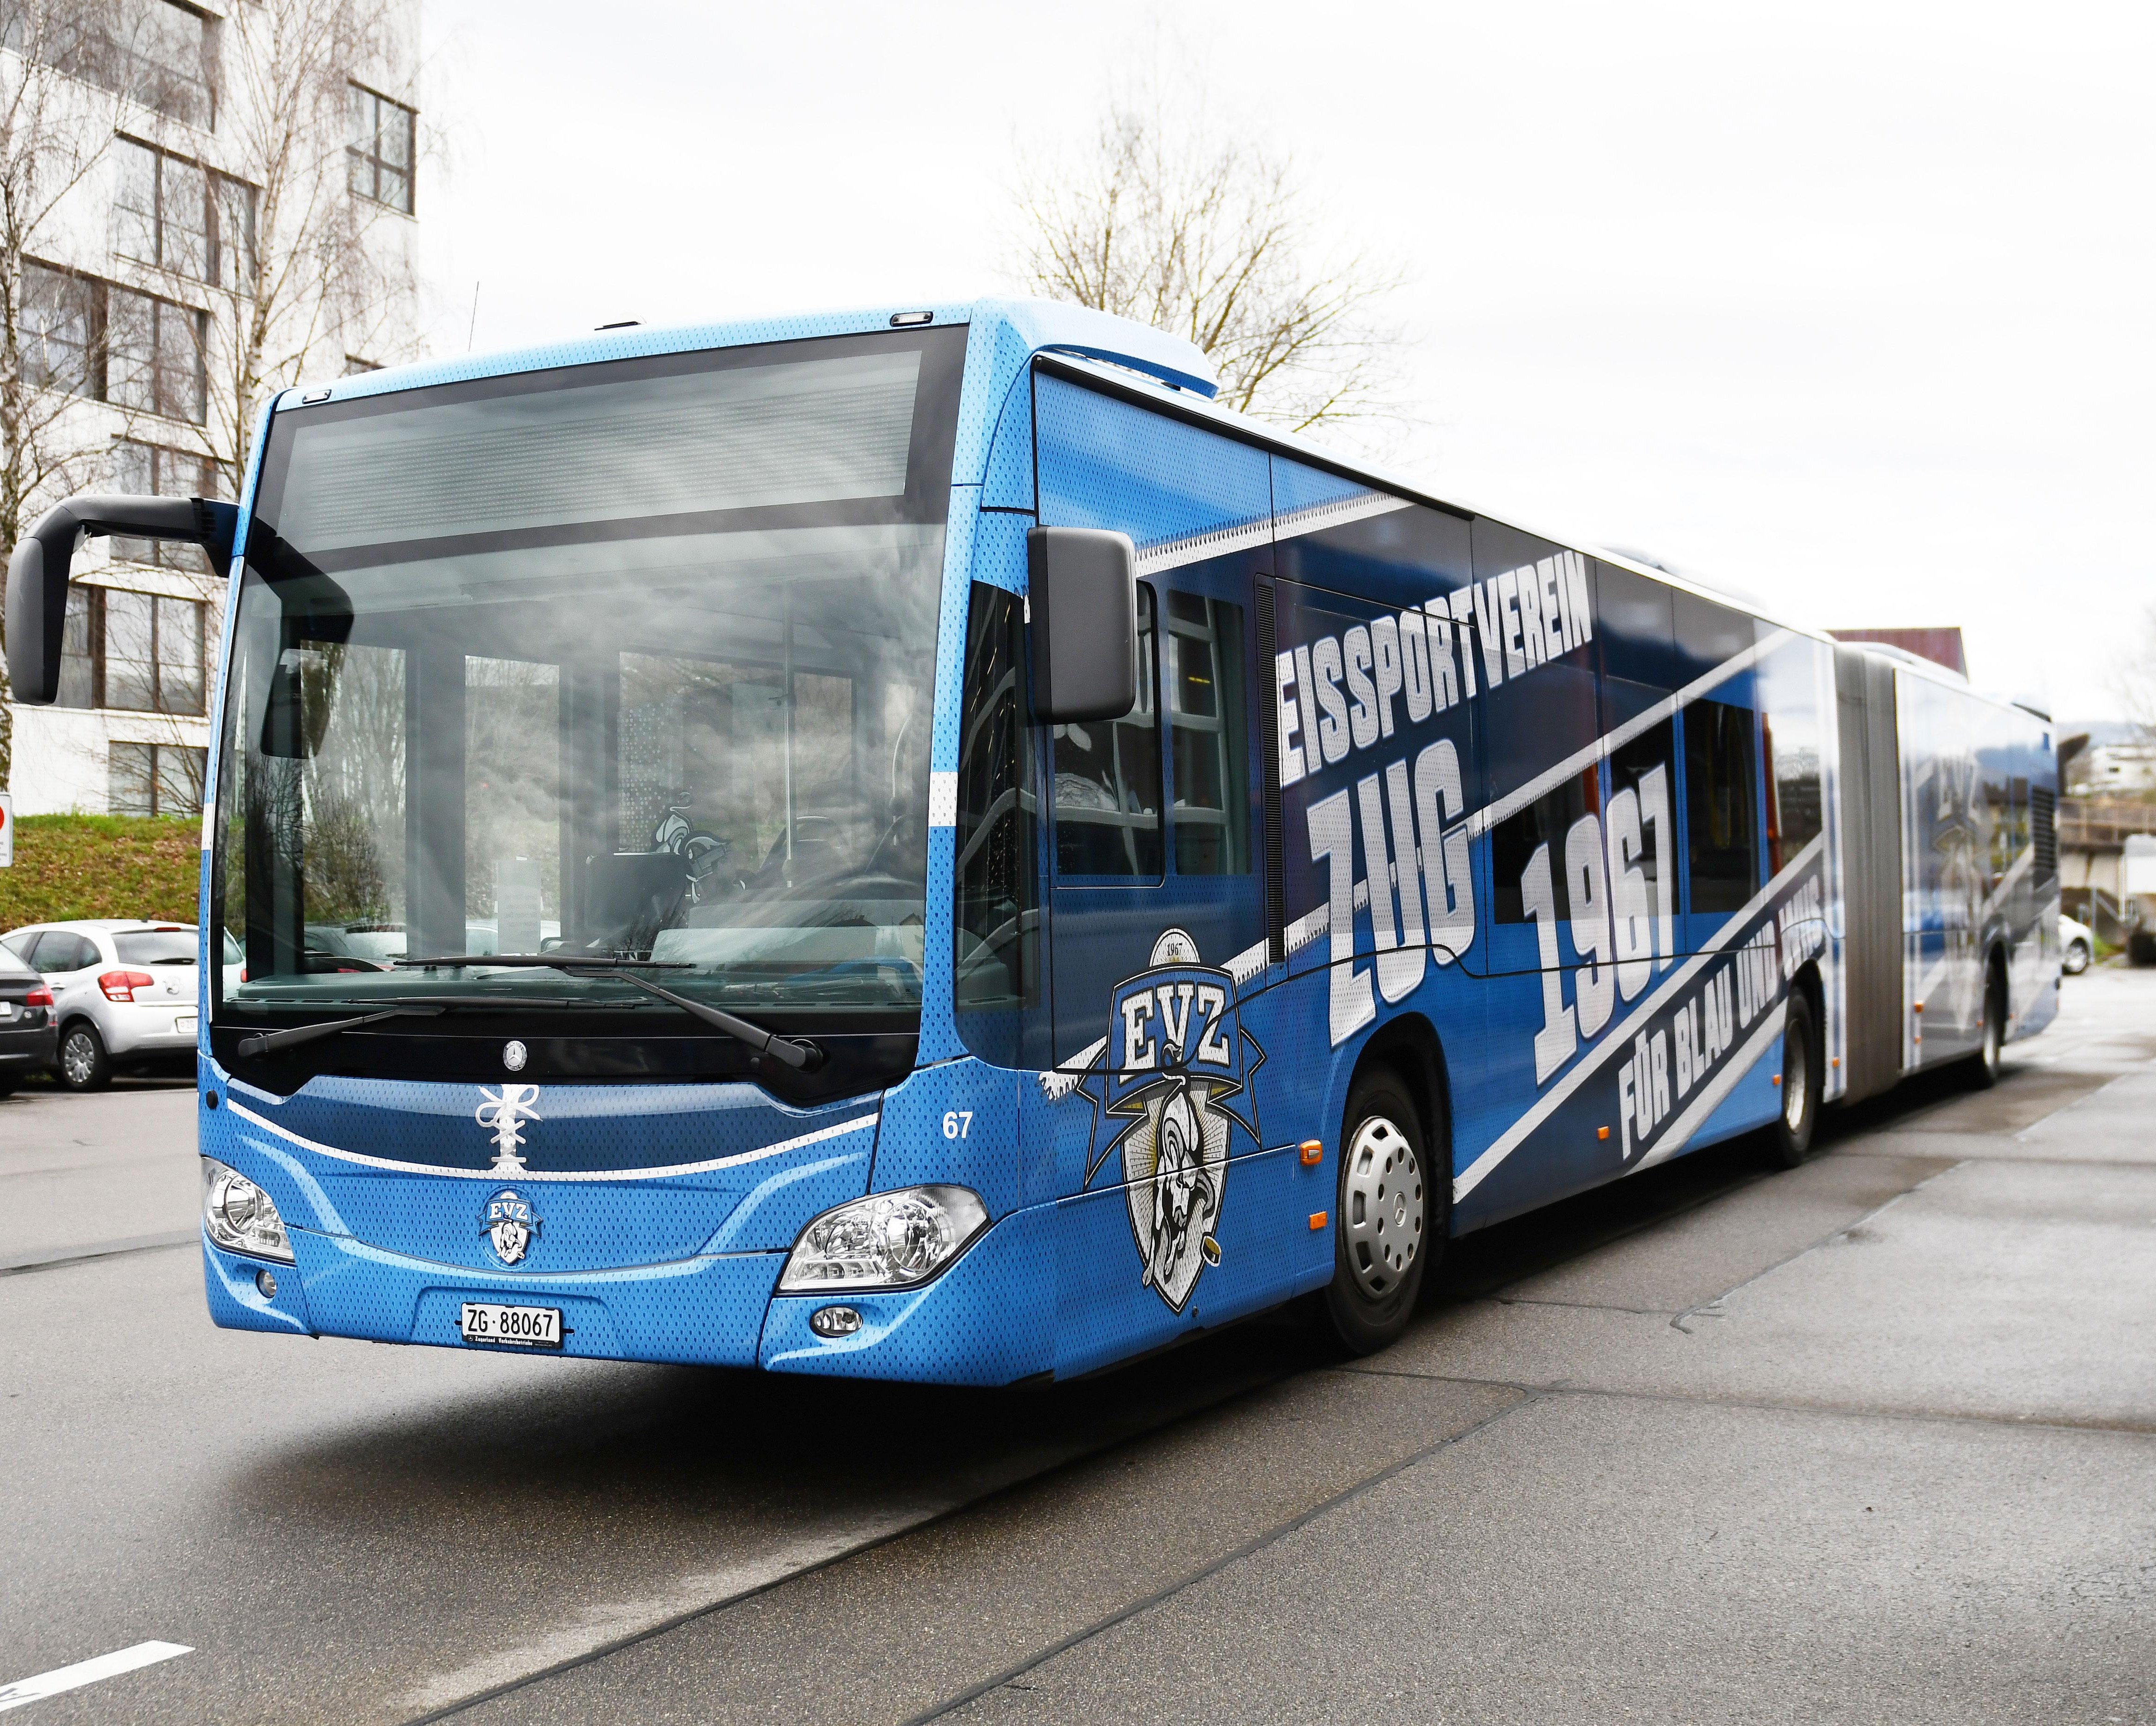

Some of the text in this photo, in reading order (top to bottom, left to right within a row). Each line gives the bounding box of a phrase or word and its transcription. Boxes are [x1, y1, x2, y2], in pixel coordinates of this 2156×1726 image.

[1275, 551, 1592, 787] EISSPORTVEREIN
[1307, 739, 1475, 1047] ZUG
[1521, 761, 1673, 1085] 1967
[1167, 943, 1183, 956] 1967
[1119, 983, 1230, 1085] EVZ
[1618, 1029, 1670, 1160] FÜR
[1673, 963, 1733, 1100] BLAU
[1736, 919, 1778, 1029] UND
[943, 1111, 973, 1139] 67
[489, 1202, 529, 1221] EVZ
[468, 1309, 553, 1337] ZG 88067
